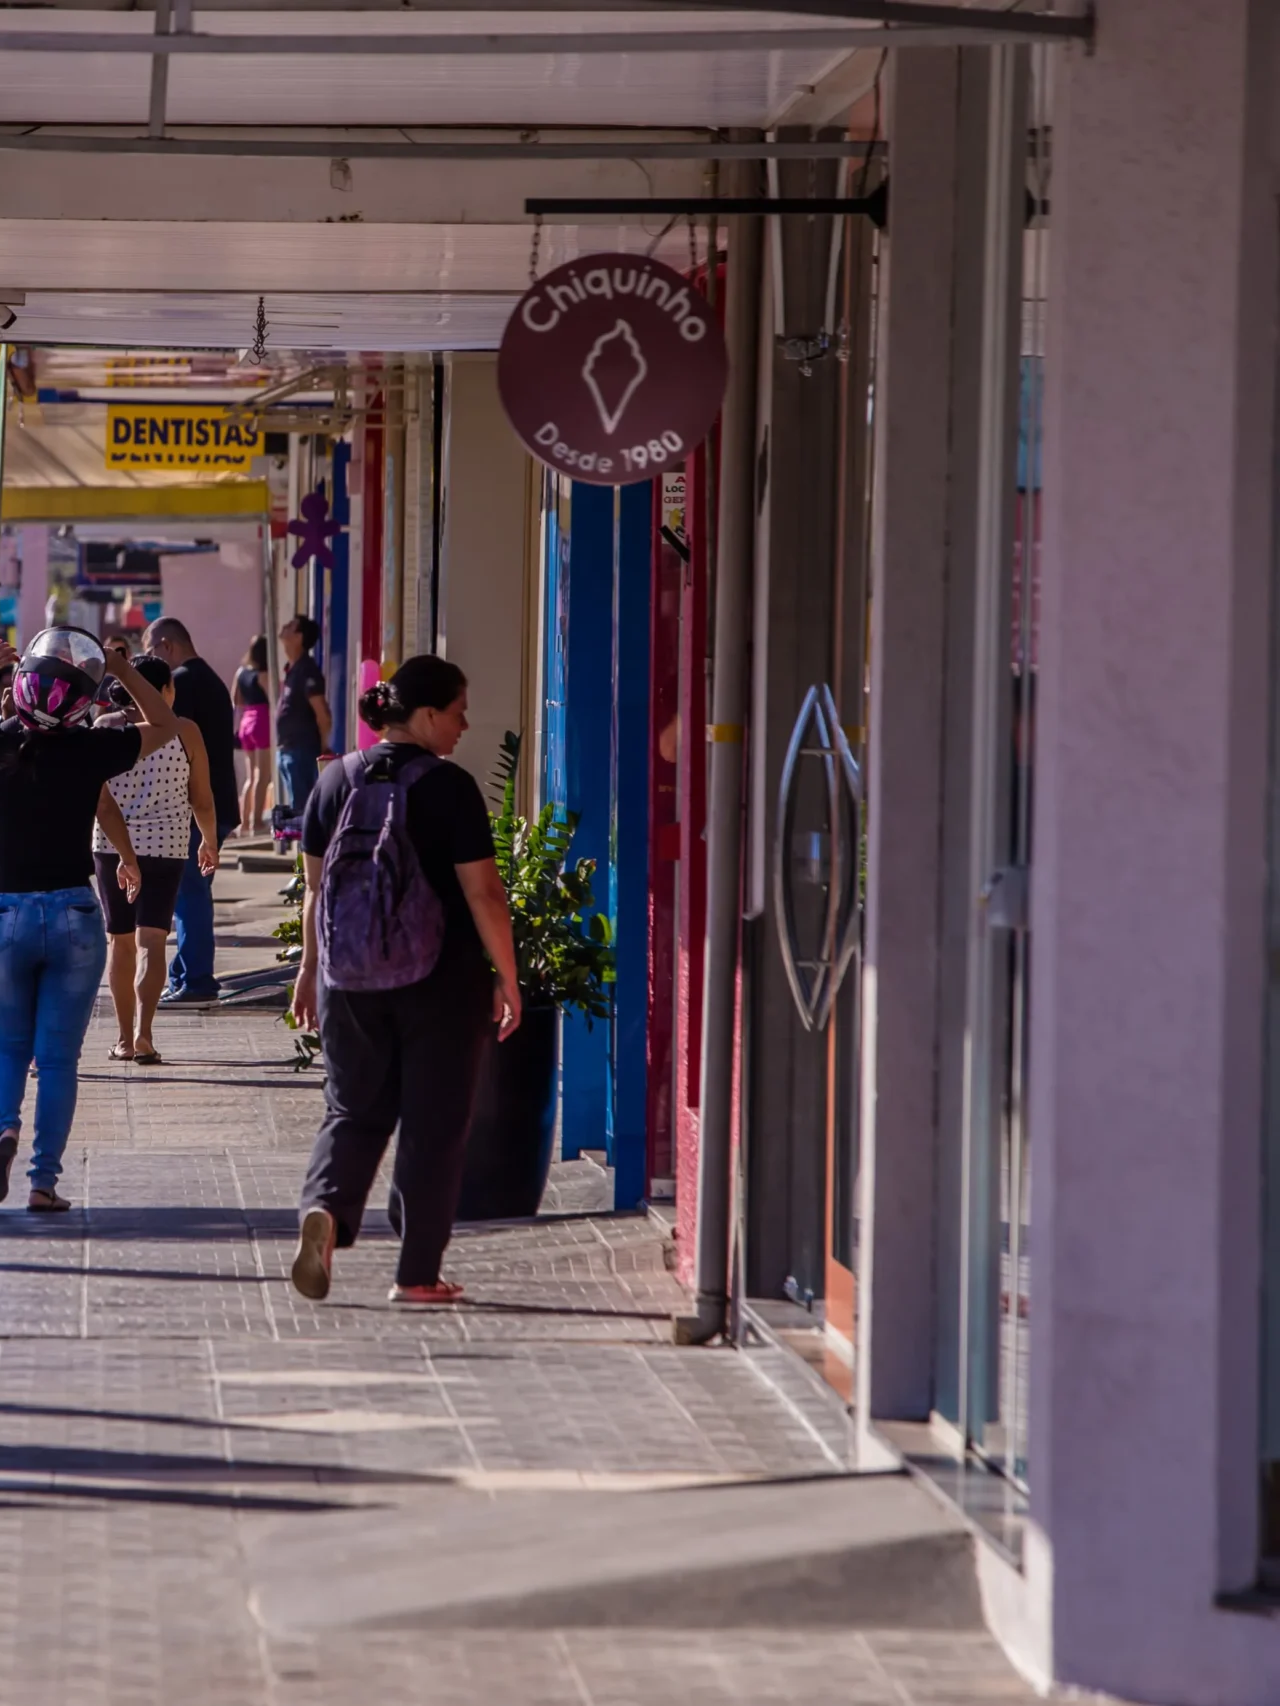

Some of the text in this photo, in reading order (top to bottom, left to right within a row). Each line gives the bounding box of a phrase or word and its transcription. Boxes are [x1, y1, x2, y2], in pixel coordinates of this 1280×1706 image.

[522, 265, 706, 342] Chiquinho
[112, 416, 259, 447] DENTISTAS
[533, 421, 684, 474] Desde 1980
